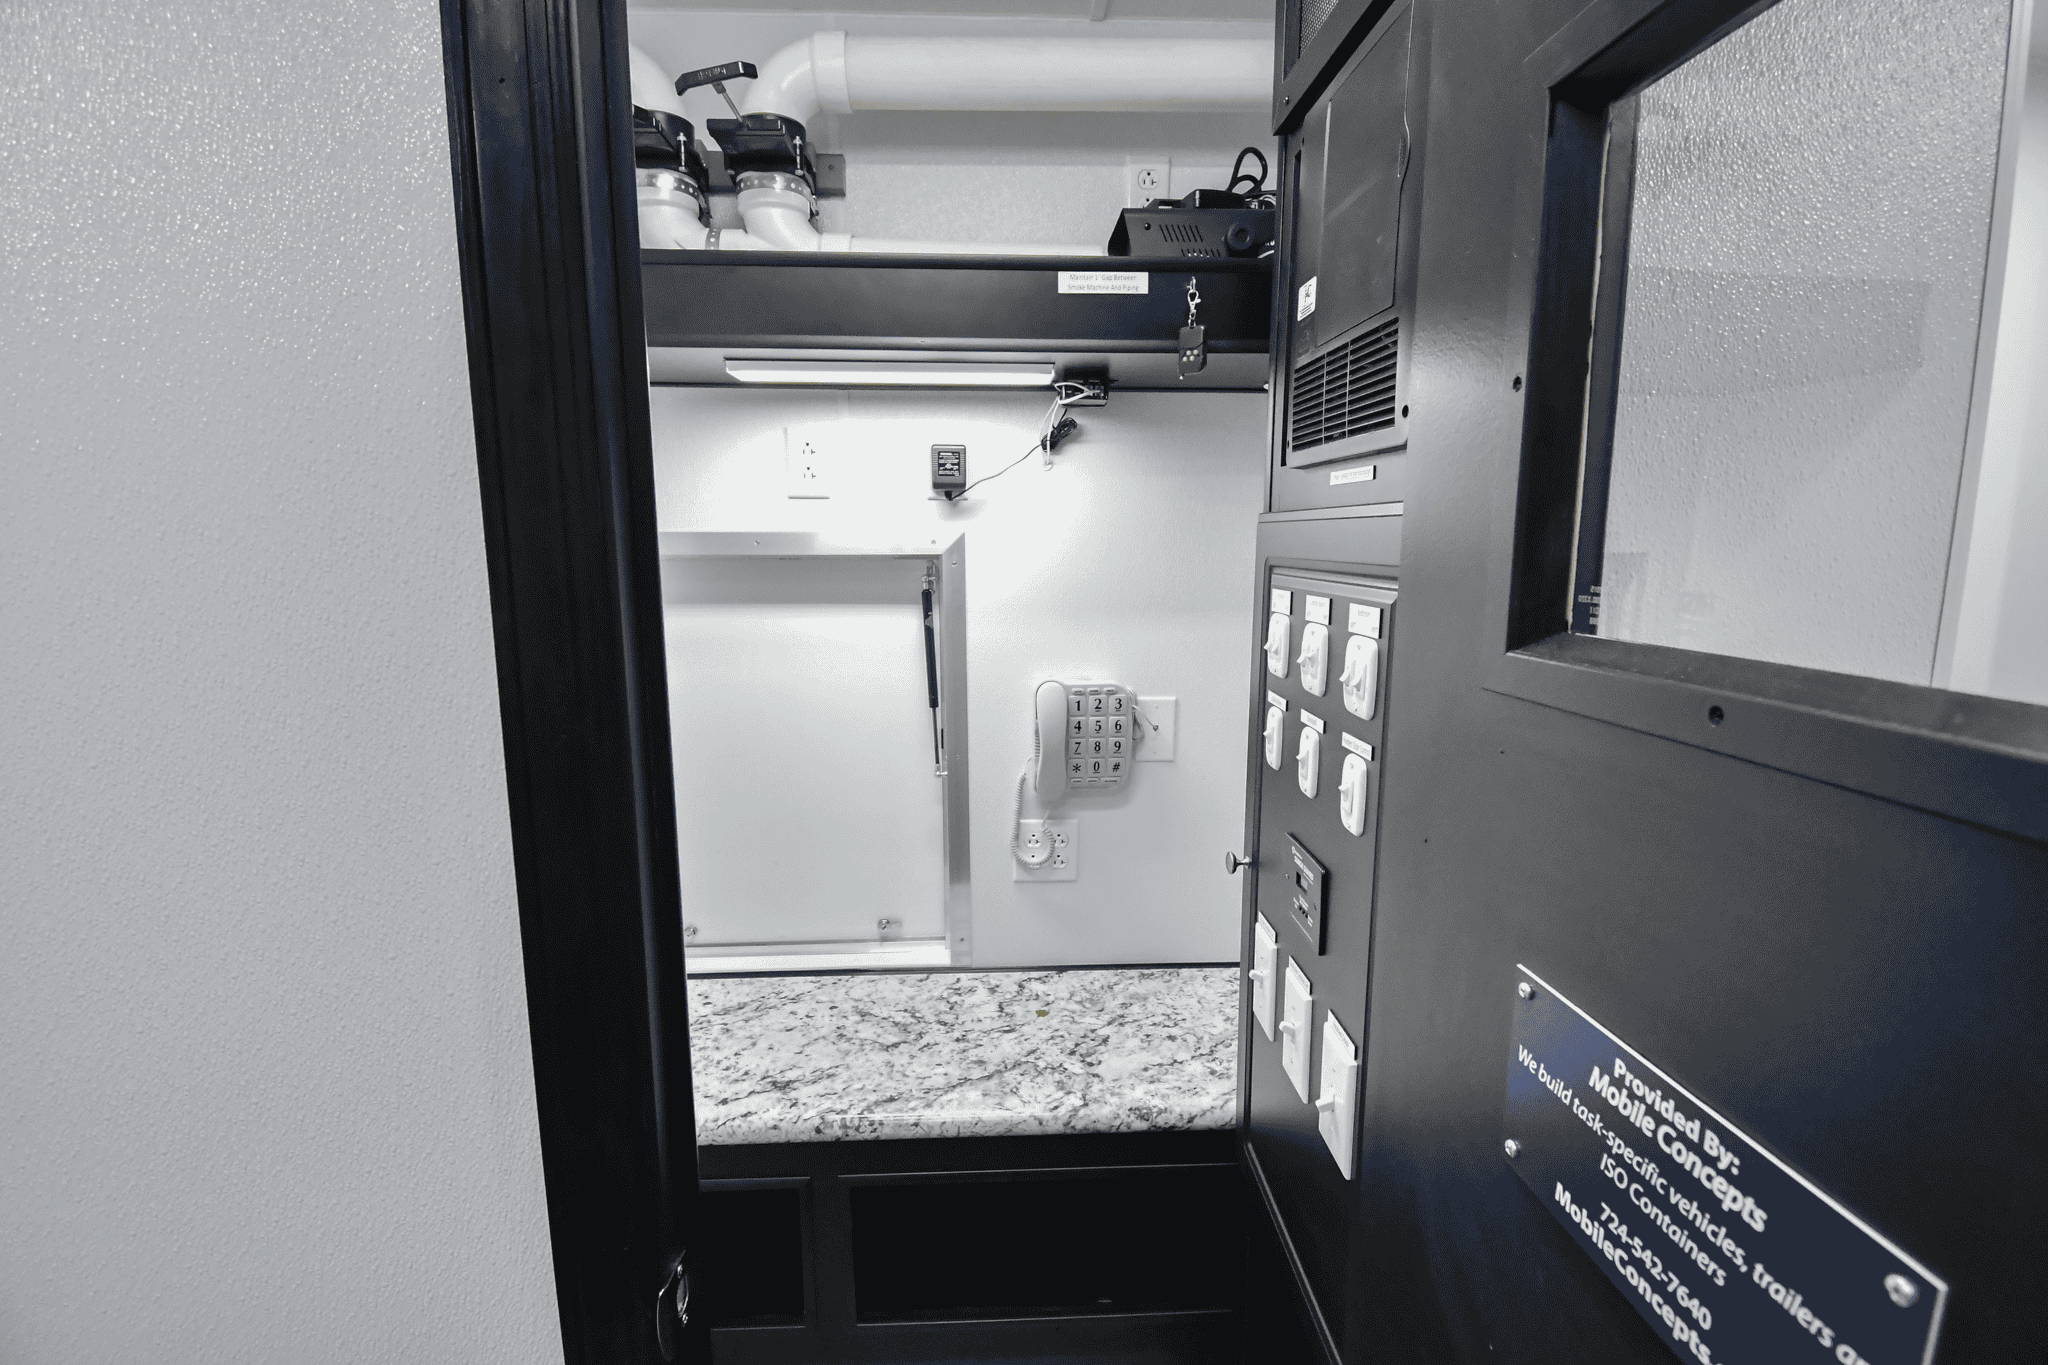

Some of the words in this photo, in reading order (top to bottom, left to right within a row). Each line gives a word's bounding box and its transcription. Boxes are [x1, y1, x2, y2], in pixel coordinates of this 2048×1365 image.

[1113, 273, 1138, 281] Between
[1067, 283, 1086, 291] Smoke
[1086, 283, 1110, 291] Machine
[1110, 283, 1122, 291] And
[1122, 283, 1140, 292] Piping
[1075, 700, 1081, 712] 1
[1094, 698, 1102, 710] 2
[1114, 698, 1122, 710] 3
[1074, 721, 1081, 732] 4
[1095, 721, 1102, 731] 5
[1115, 720, 1122, 731] 6
[1074, 742, 1082, 753] 7
[1094, 741, 1101, 752] 8
[1114, 741, 1122, 752] 9
[1093, 761, 1100, 772] 0
[1613, 1057, 1701, 1143] Provided
[1703, 1129, 1740, 1176] By:
[1588, 1065, 1656, 1137] Mobile
[1657, 1124, 1768, 1233] Concepts
[1518, 1044, 1538, 1074] We
[1537, 1063, 1573, 1106] build
[1572, 1098, 1668, 1195] task-specific
[1669, 1185, 1748, 1273] vehicles,
[1752, 1263, 1836, 1348] trailers
[1600, 1153, 1628, 1190] ISO
[1629, 1183, 1727, 1287] Containers
[1600, 1202, 1712, 1331] 724-542-7640
